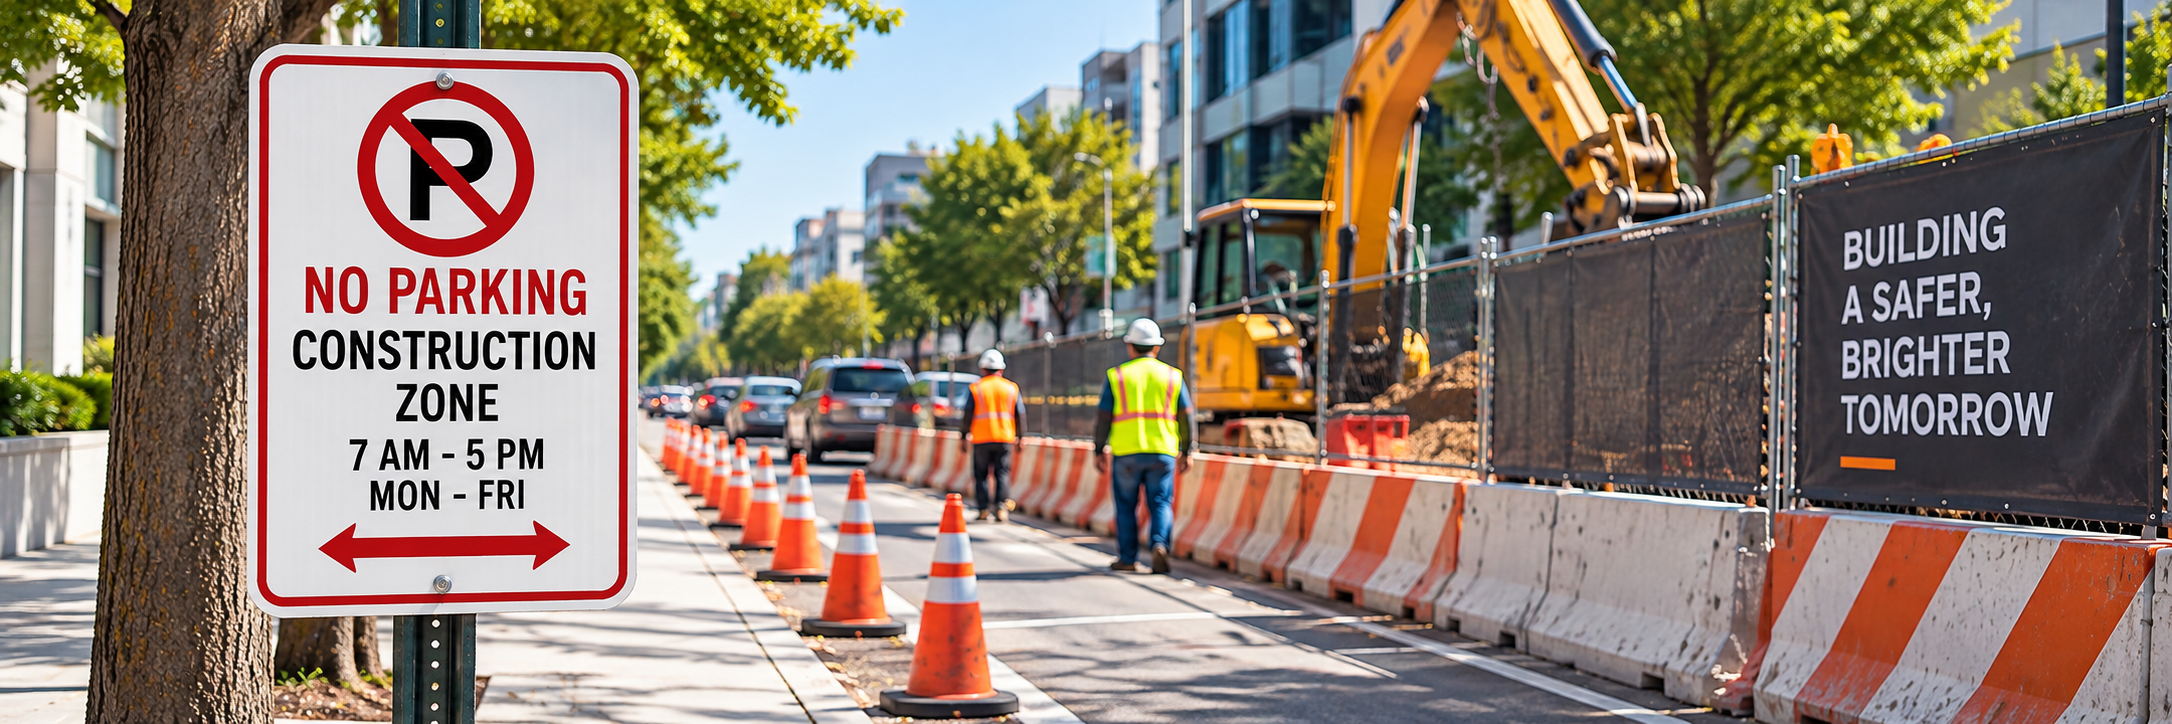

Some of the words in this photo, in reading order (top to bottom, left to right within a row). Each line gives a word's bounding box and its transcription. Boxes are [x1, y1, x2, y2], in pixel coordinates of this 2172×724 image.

[410, 119, 493, 220] P
[1844, 207, 2006, 270] BUILDING
[306, 266, 368, 314] NO
[390, 268, 586, 316] PARKING
[1842, 286, 1863, 324] A
[1871, 271, 1992, 321] SAFER,
[293, 330, 595, 370] CONSTRUCTION
[1842, 331, 2010, 379] BRIGHTER
[396, 383, 498, 421] ZONE
[1841, 392, 2053, 436] TOMORROW
[350, 439, 367, 470] 7
[379, 439, 428, 470] AM
[467, 439, 484, 470] 5
[498, 439, 543, 469] PM
[371, 480, 439, 510] MON
[480, 480, 524, 509] FRI
